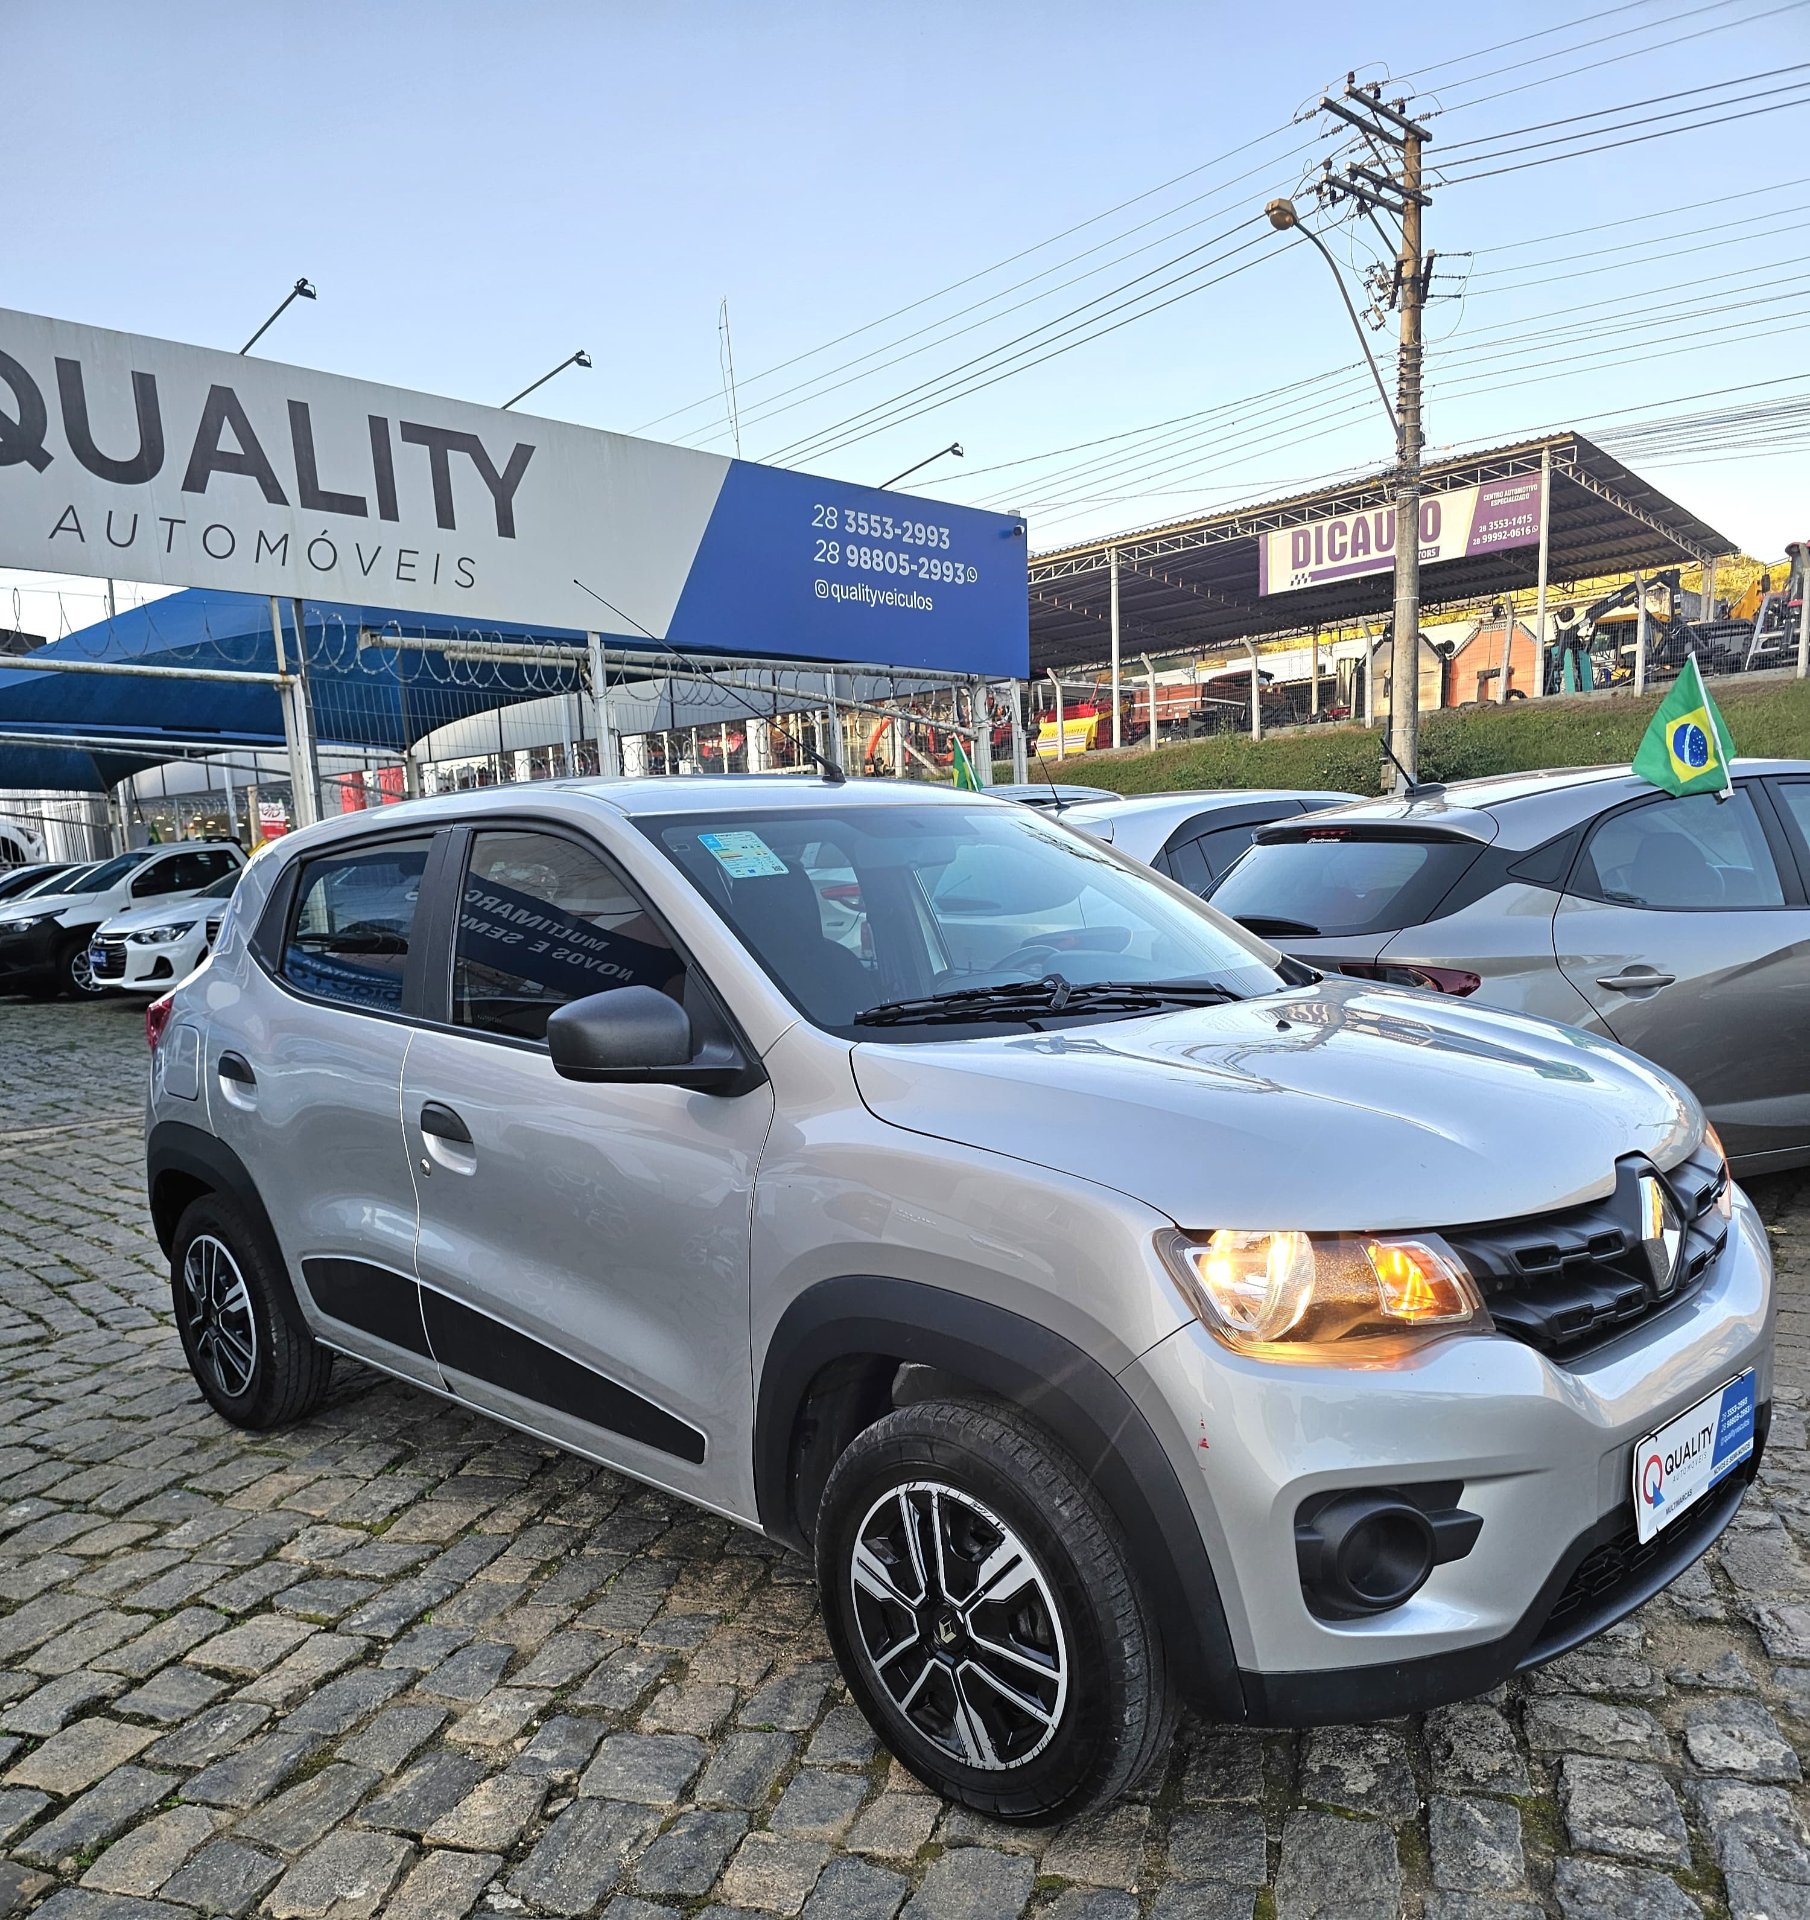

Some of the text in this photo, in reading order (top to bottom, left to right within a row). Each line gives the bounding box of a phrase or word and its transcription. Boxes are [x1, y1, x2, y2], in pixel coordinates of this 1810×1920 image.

[1483, 484, 1538, 501] CENTRO AUTOMOTIVO
[1490, 493, 1530, 507] ESPECIALIZADO
[811, 504, 950, 550] 28 3553-2993
[1292, 500, 1441, 570] DICAUO
[1472, 526, 1531, 546] 28 99992-0616
[1479, 513, 1533, 533] 28 3553-1415
[49, 504, 477, 589] AUTOMÓVEIS
[814, 540, 965, 585] 28 98805-2993
[1665, 1422, 1714, 1476] QUALITY
